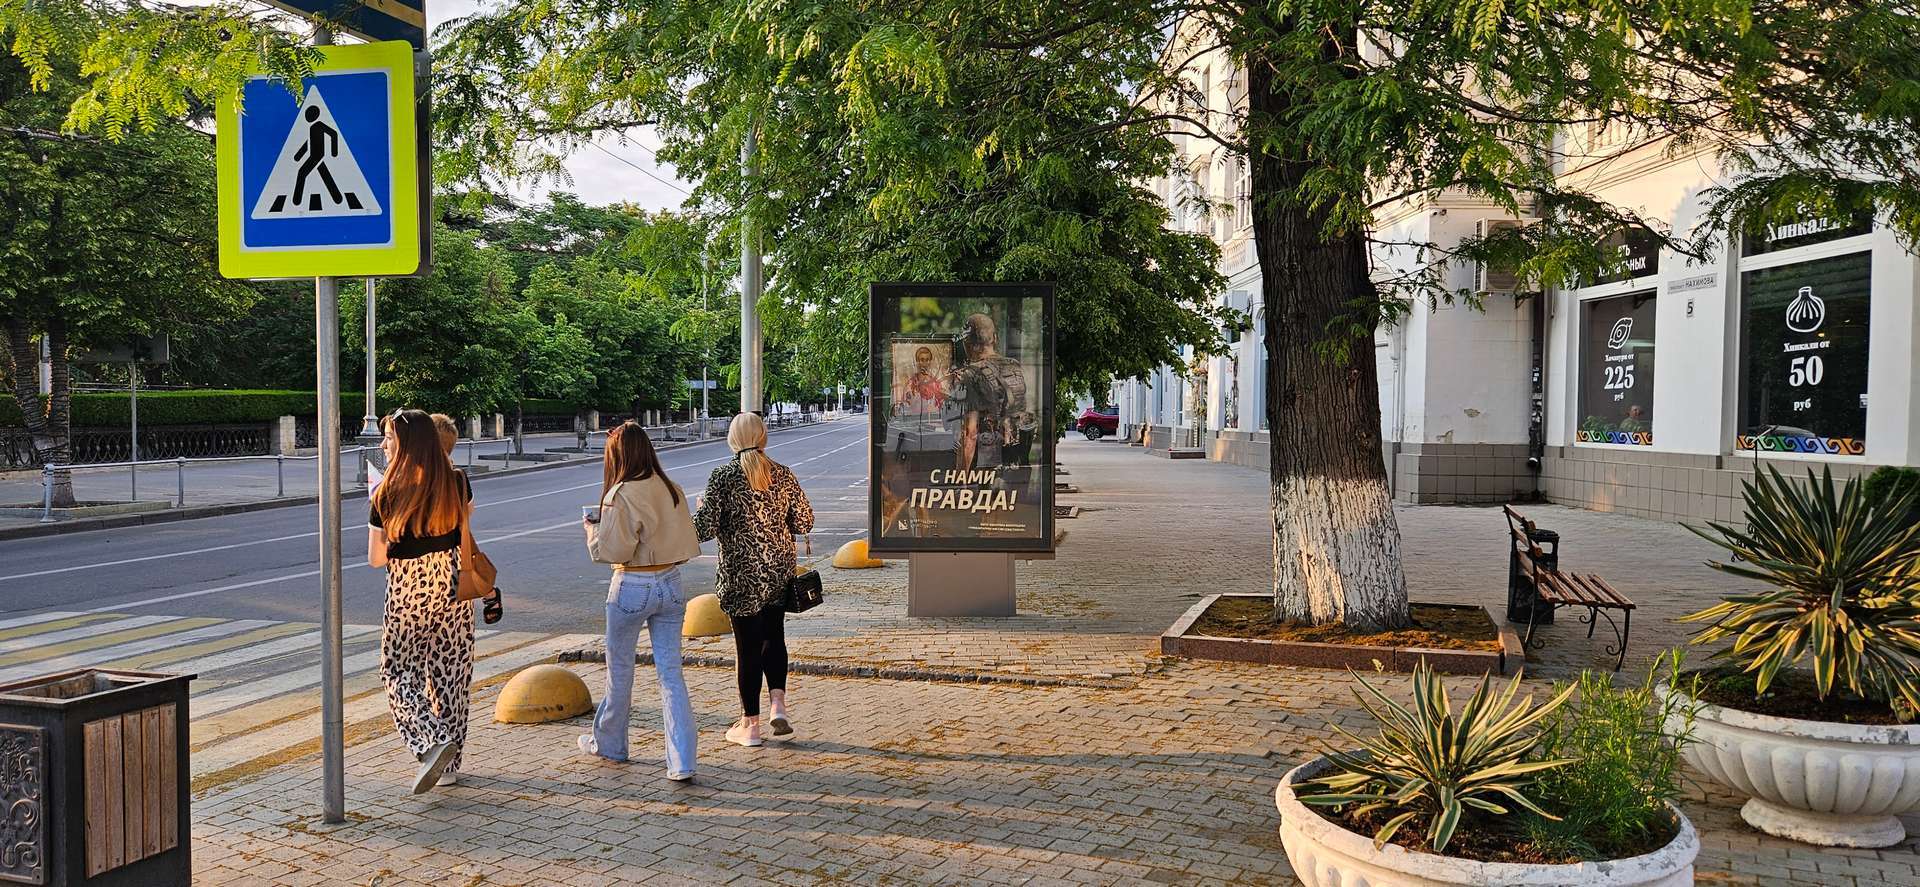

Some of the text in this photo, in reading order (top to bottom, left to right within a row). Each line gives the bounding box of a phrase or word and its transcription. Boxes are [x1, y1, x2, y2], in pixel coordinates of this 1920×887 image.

[1687, 301, 1694, 315] 5
[1783, 342, 1819, 352] Хинкали
[1604, 364, 1635, 390] 225
[1789, 355, 1824, 387] 50
[1614, 391, 1625, 401] руб
[1793, 398, 1812, 411] руб
[930, 468, 996, 485] С НАМИ
[910, 488, 1017, 514] ПРАВДА!
